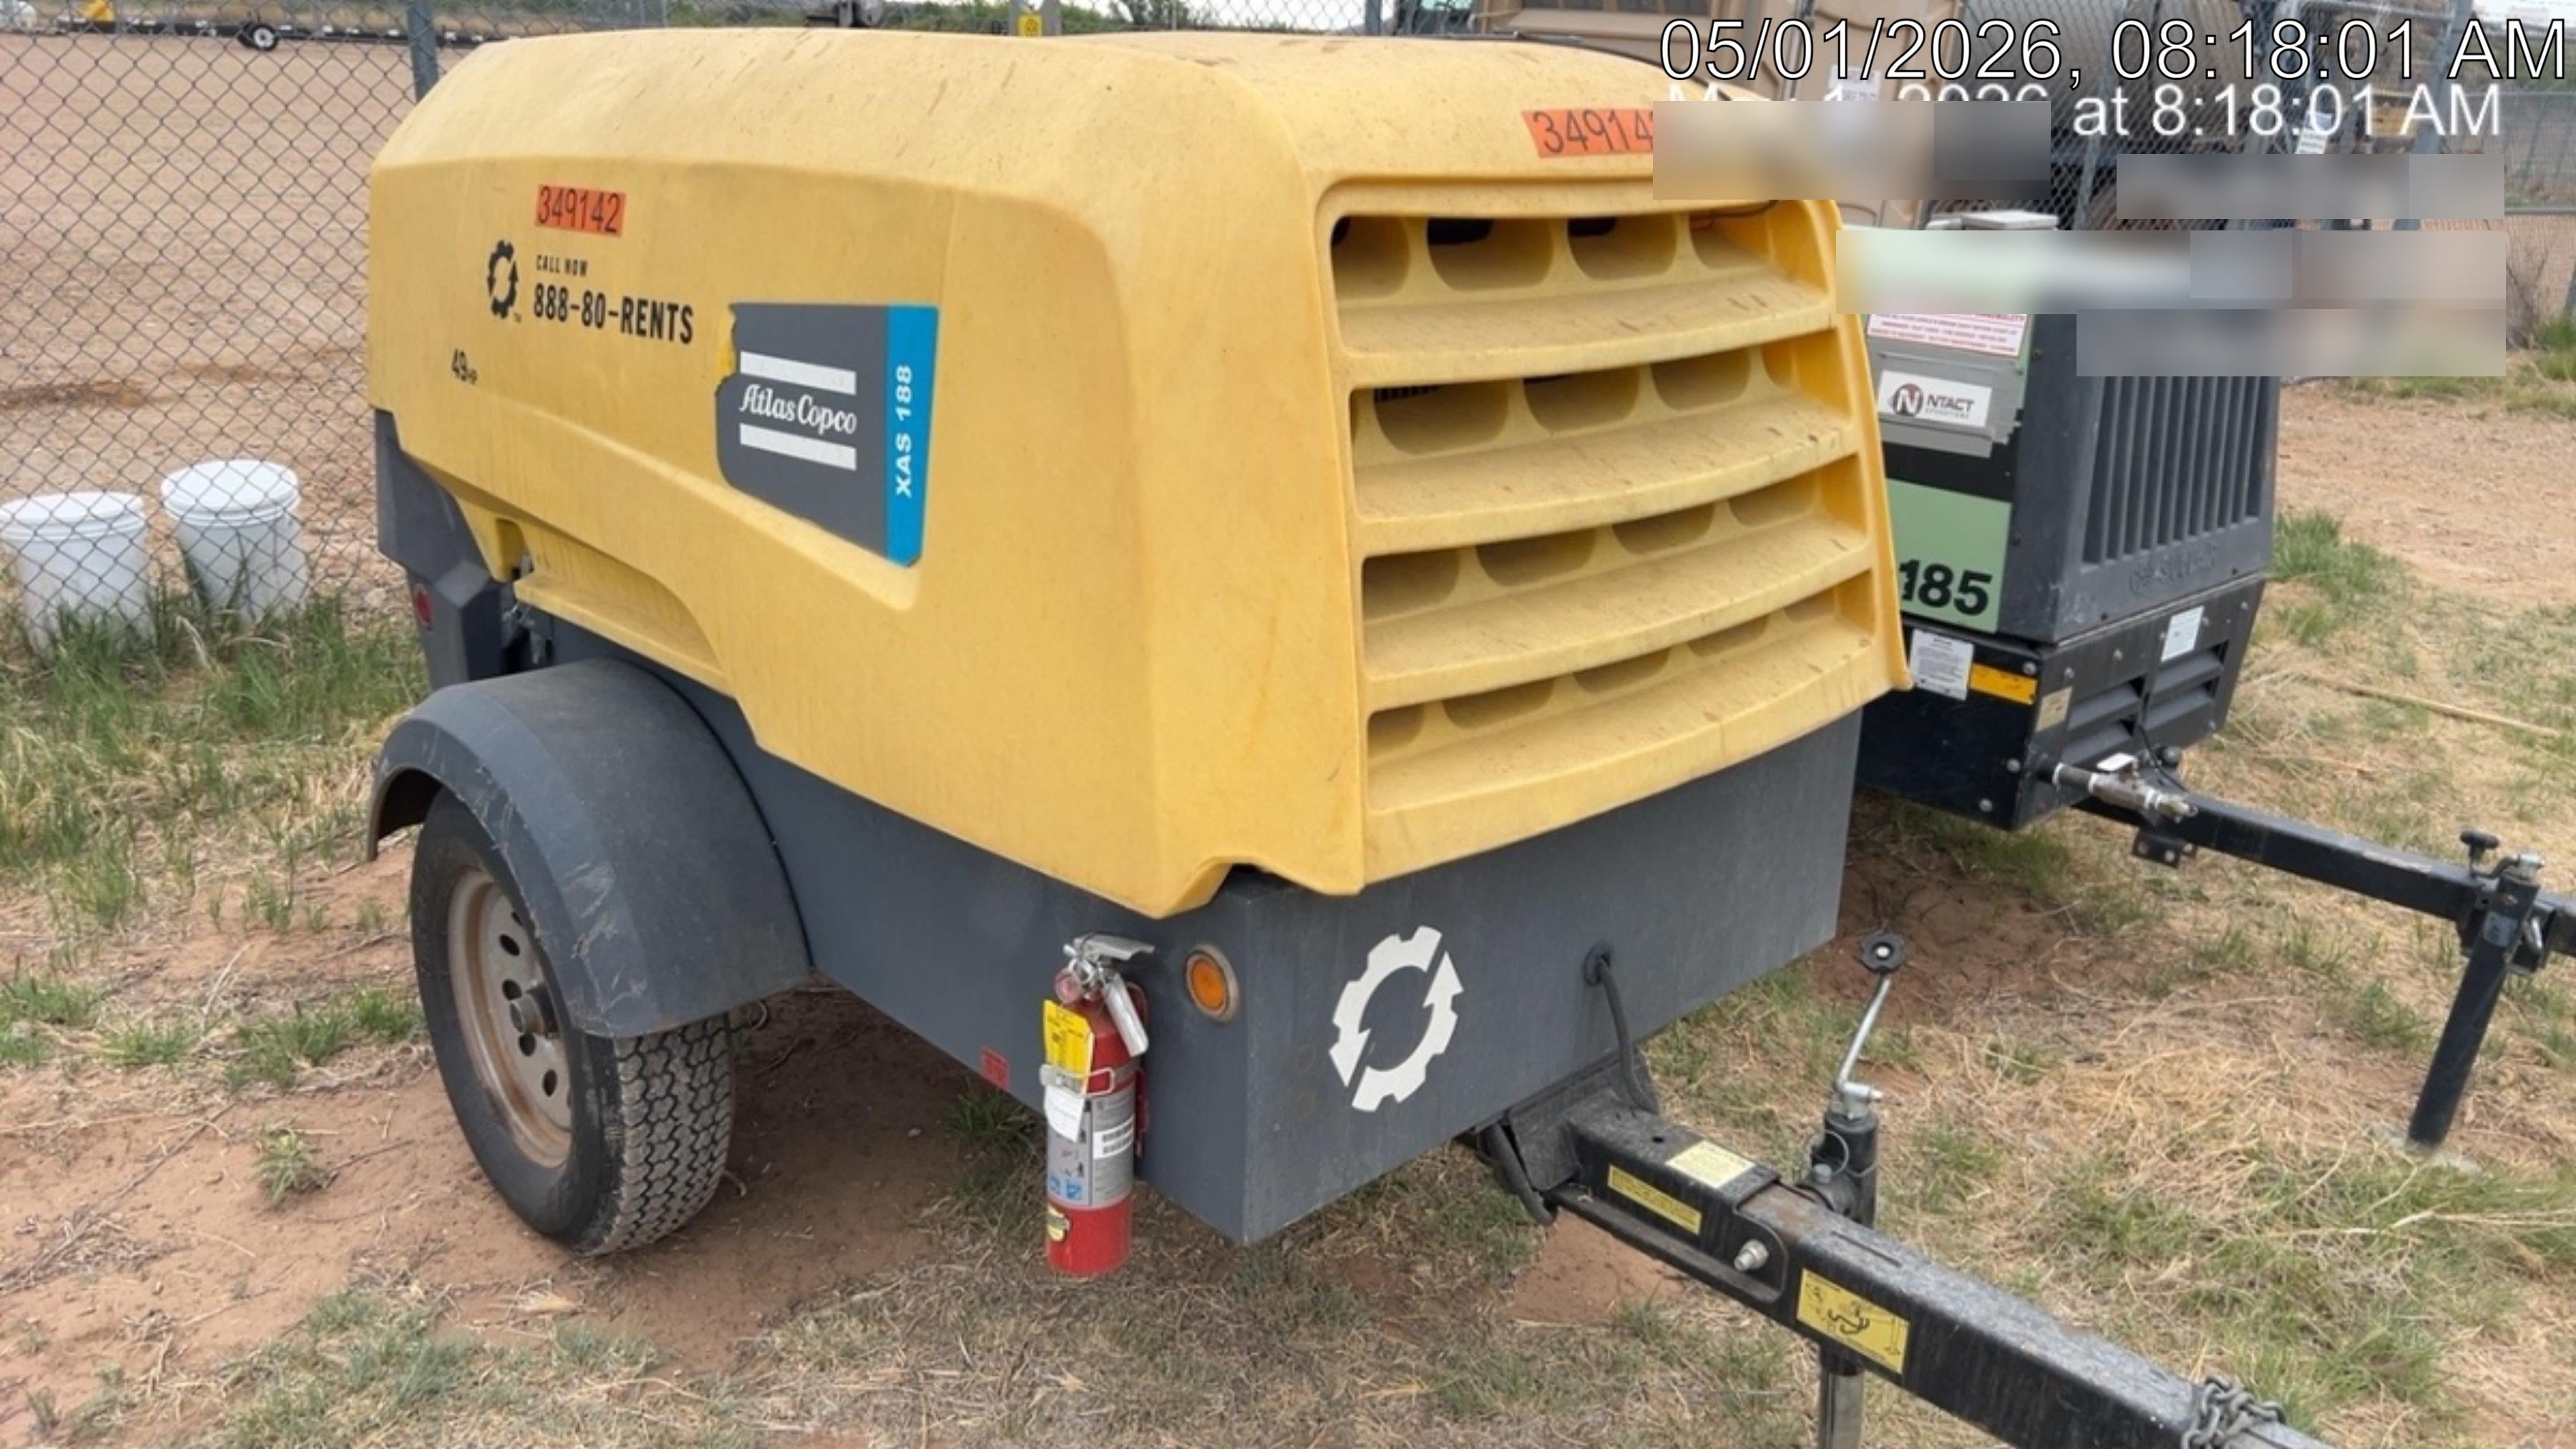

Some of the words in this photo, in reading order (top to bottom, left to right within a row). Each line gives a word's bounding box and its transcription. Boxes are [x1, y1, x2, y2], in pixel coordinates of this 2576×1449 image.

[1533, 109, 1653, 153] 34914
[538, 186, 620, 233] 349142
[537, 255, 560, 274] CALL
[565, 258, 588, 277] NOW
[534, 283, 693, 344] 888-80-RENTS
[739, 384, 796, 421] Atlas
[798, 394, 857, 435] Copco
[895, 366, 912, 421] 188
[1927, 394, 1974, 412] NTACT
[896, 433, 912, 498] XAS
[1899, 556, 1993, 616] 185
